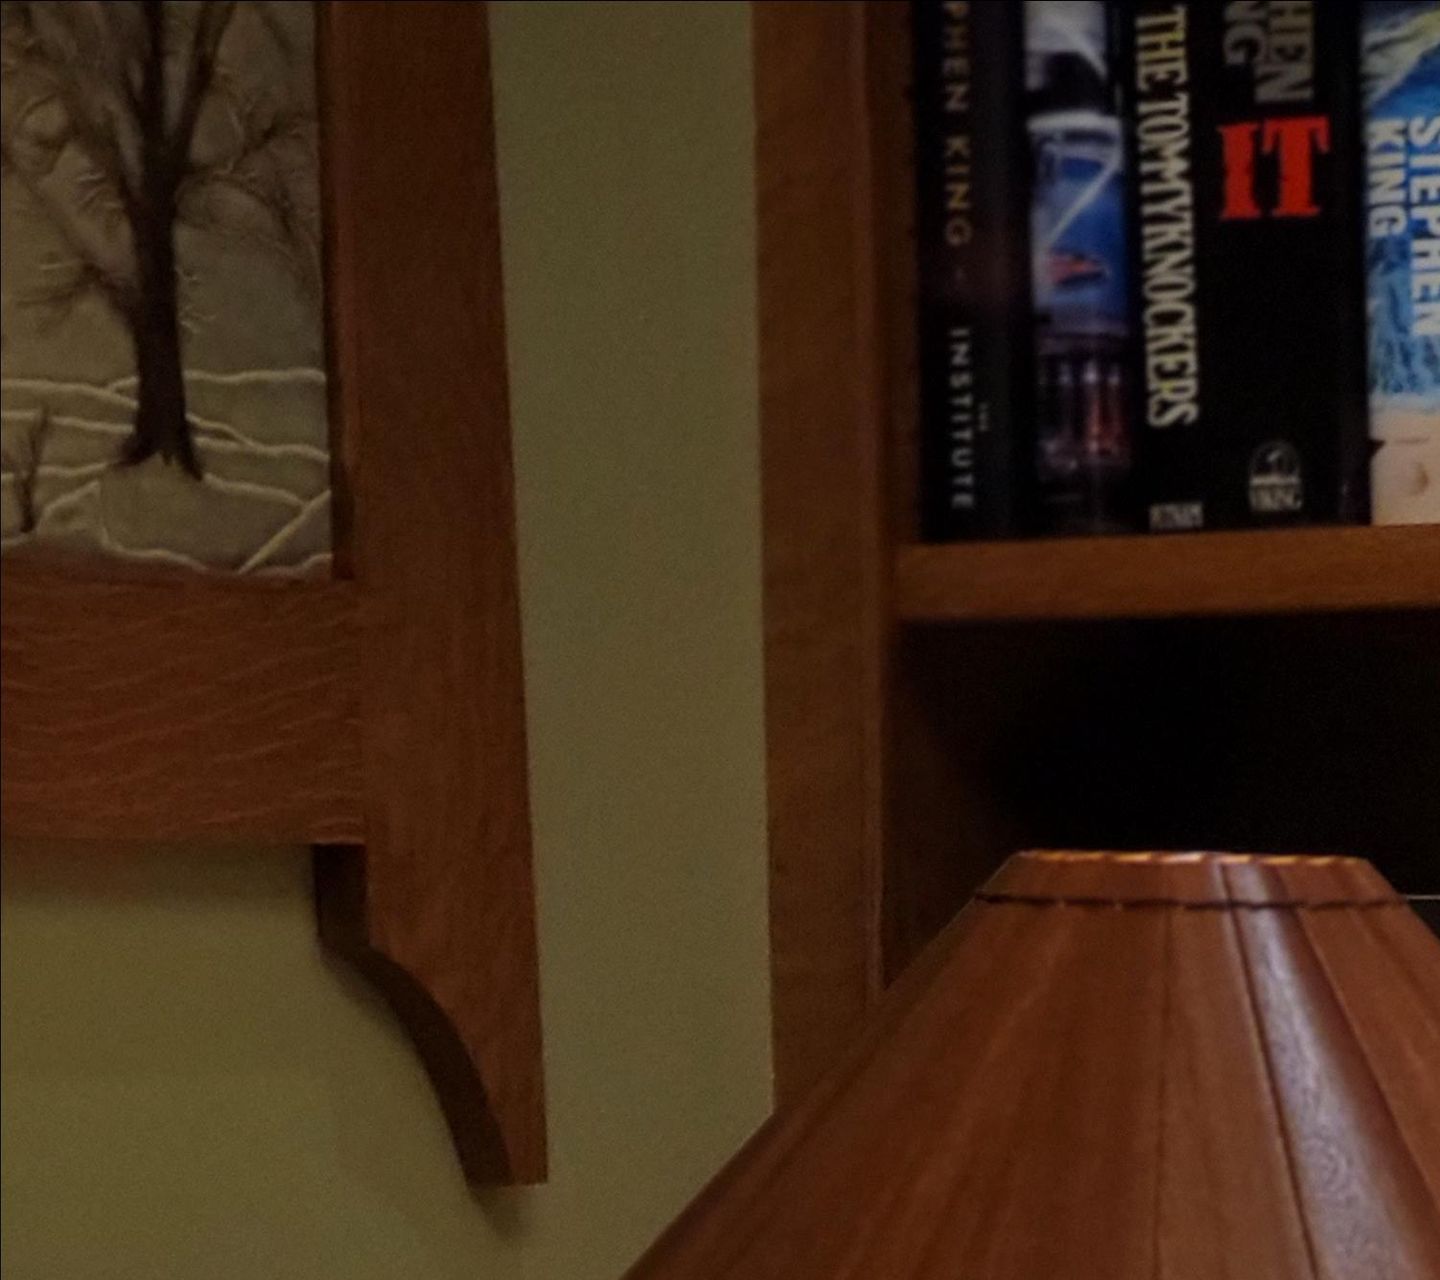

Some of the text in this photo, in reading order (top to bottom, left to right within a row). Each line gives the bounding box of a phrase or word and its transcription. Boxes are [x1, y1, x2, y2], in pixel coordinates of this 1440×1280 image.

[943, 134, 973, 247] KING
[1135, 4, 1199, 428] THE TOMMYKNOCKERS
[1217, 115, 1330, 220] IT
[1366, 118, 1407, 237] KING
[949, 328, 977, 508] INSTITUTE
